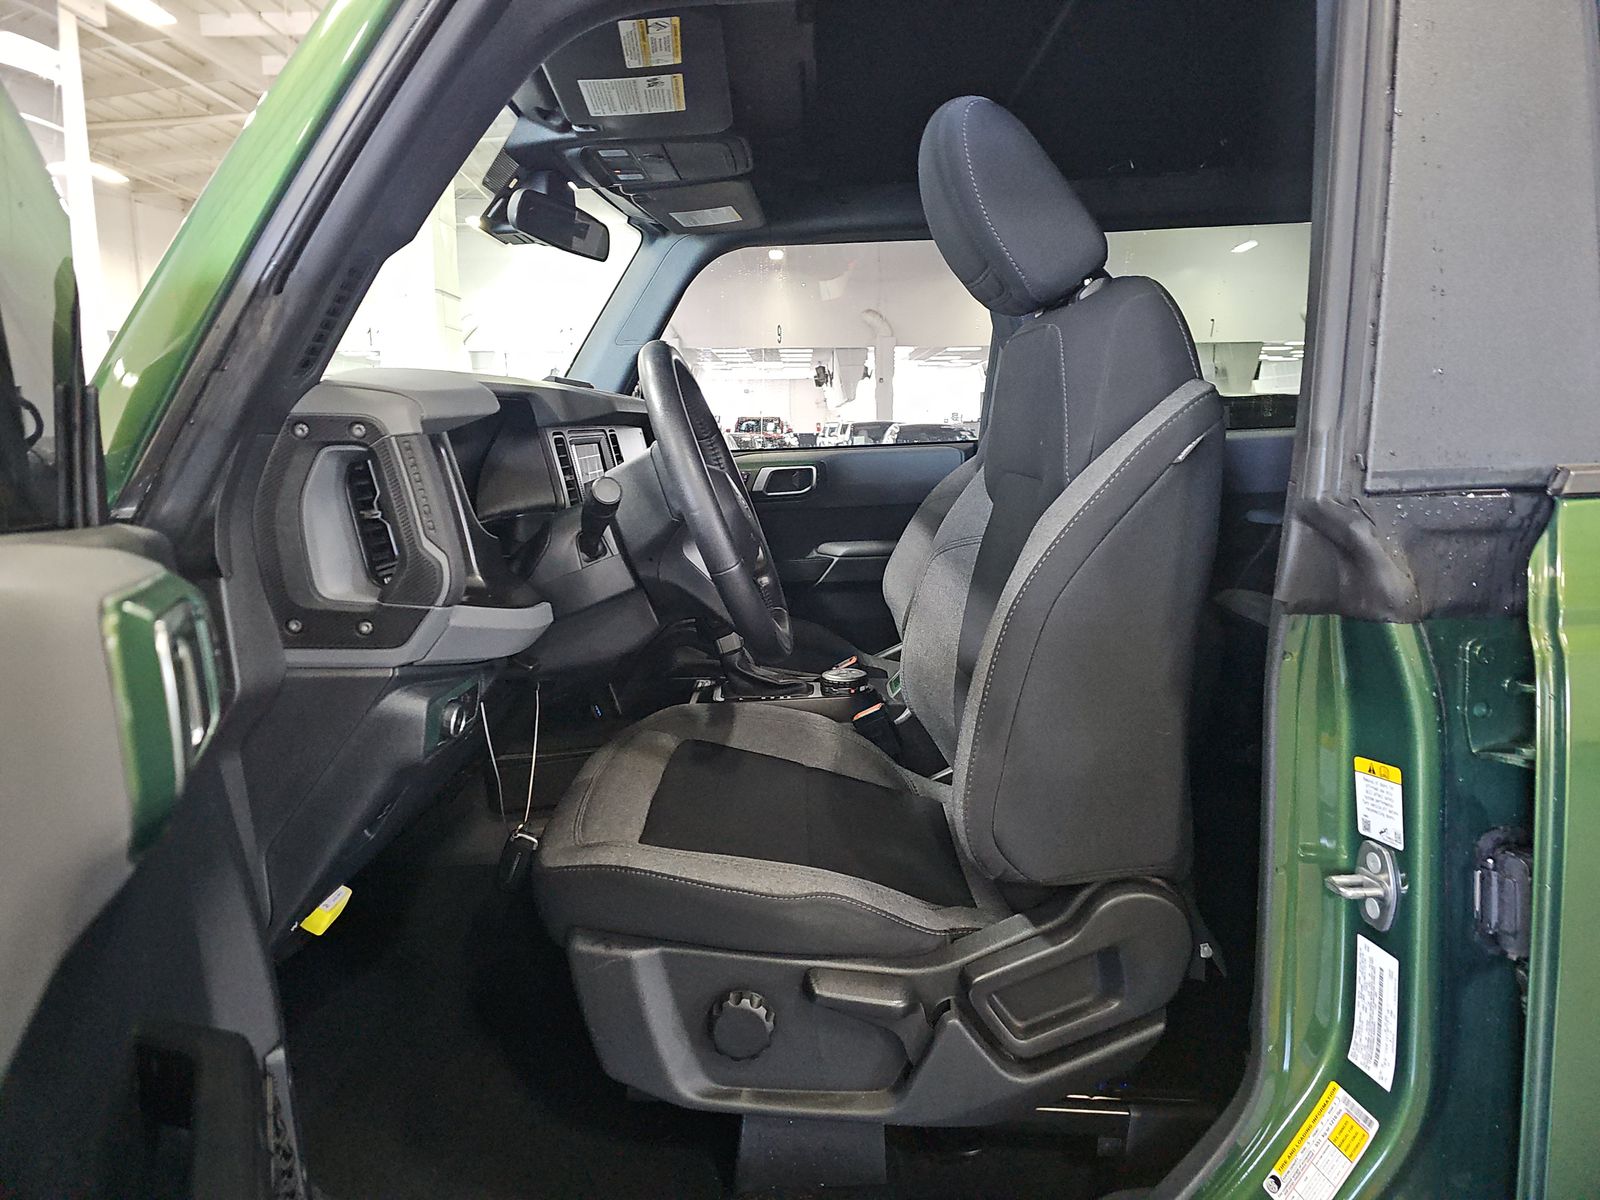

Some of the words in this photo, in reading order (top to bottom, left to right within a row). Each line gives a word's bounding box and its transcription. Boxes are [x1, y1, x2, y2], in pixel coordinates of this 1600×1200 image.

[1278, 1159, 1288, 1172] TIRE
[1287, 1147, 1296, 1159] AND
[1295, 1123, 1312, 1147] LOADING
[1311, 1087, 1337, 1124] INFORMATION
